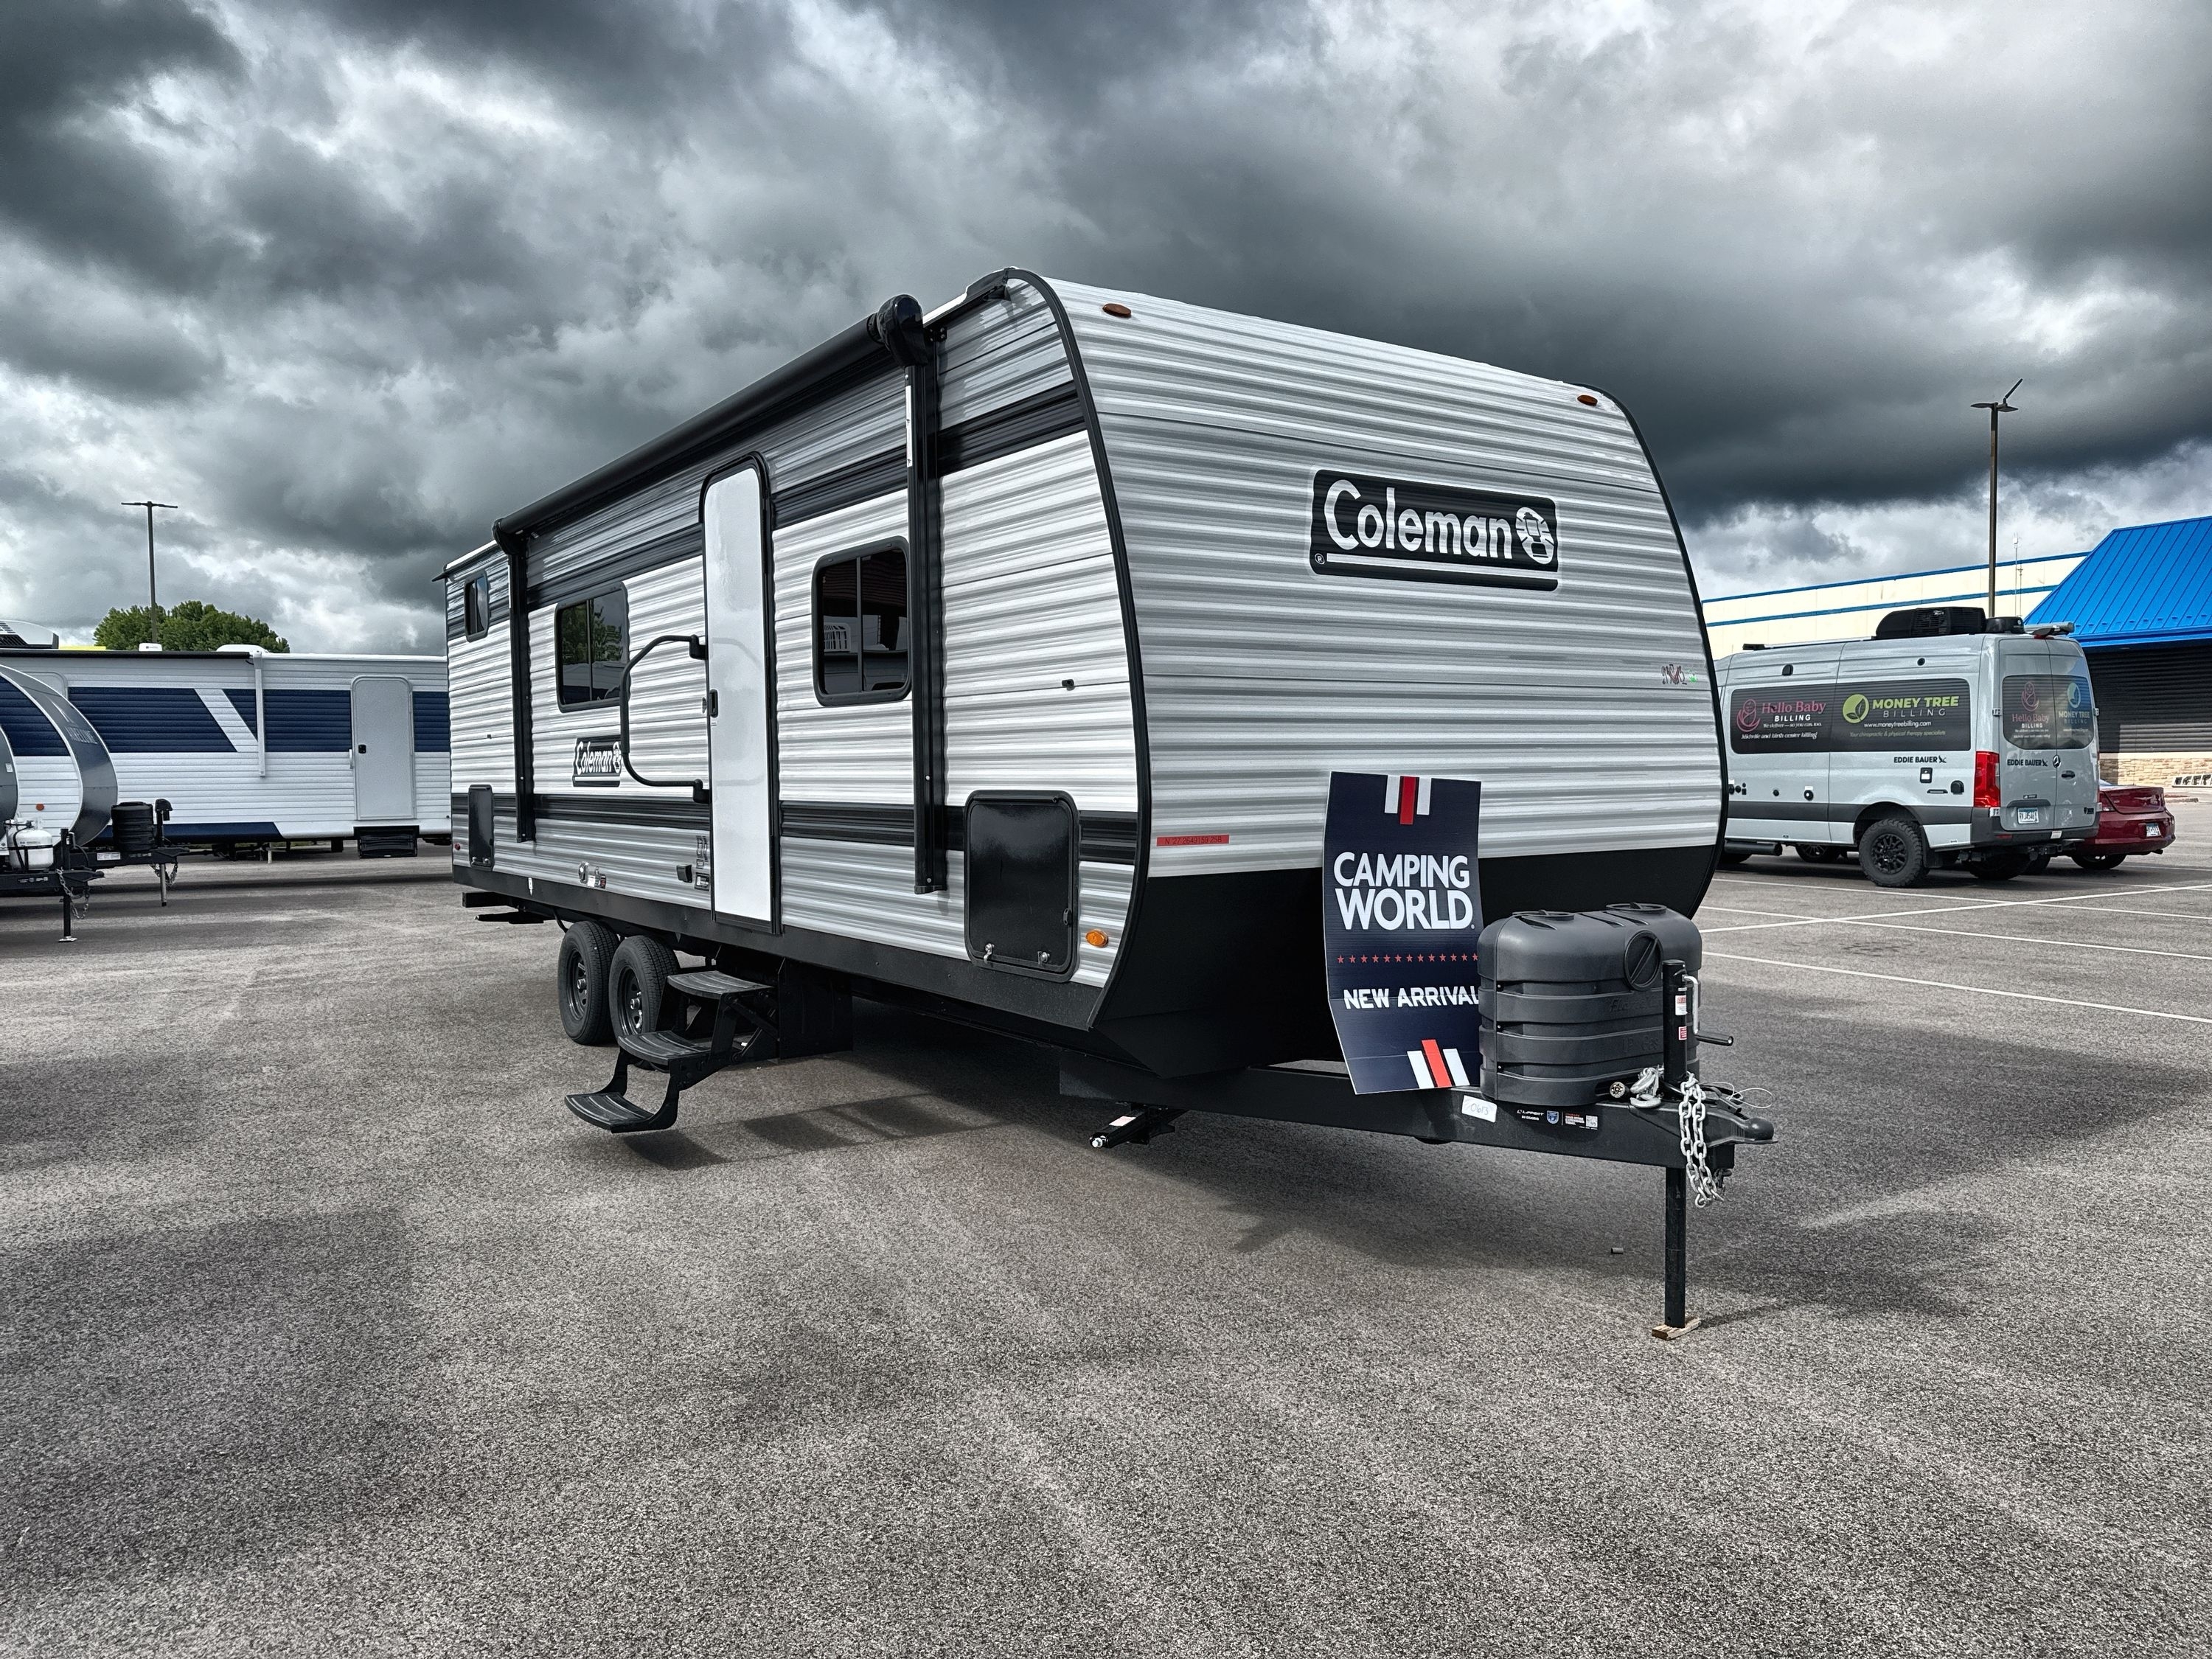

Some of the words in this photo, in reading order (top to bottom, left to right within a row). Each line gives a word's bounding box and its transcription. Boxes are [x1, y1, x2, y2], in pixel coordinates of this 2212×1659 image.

[1324, 479, 1512, 560] Coleman
[1761, 701, 1792, 714] Hello
[1795, 700, 1826, 714] Baby
[1872, 698, 1921, 709] MONEY
[1924, 695, 1960, 707] TREE
[1774, 714, 1811, 722] BILLING
[1882, 709, 1947, 718] BILLING
[2011, 713, 2031, 723] Hello
[2033, 713, 2050, 724] Baby
[575, 741, 613, 776] Coleman
[1334, 852, 1470, 888] CAMPING
[1335, 888, 1473, 931] WORLD
[1343, 988, 1390, 1009] NEW
[1397, 986, 1479, 1008] ARRIVAL
[1470, 1102, 1489, 1116] 0613
